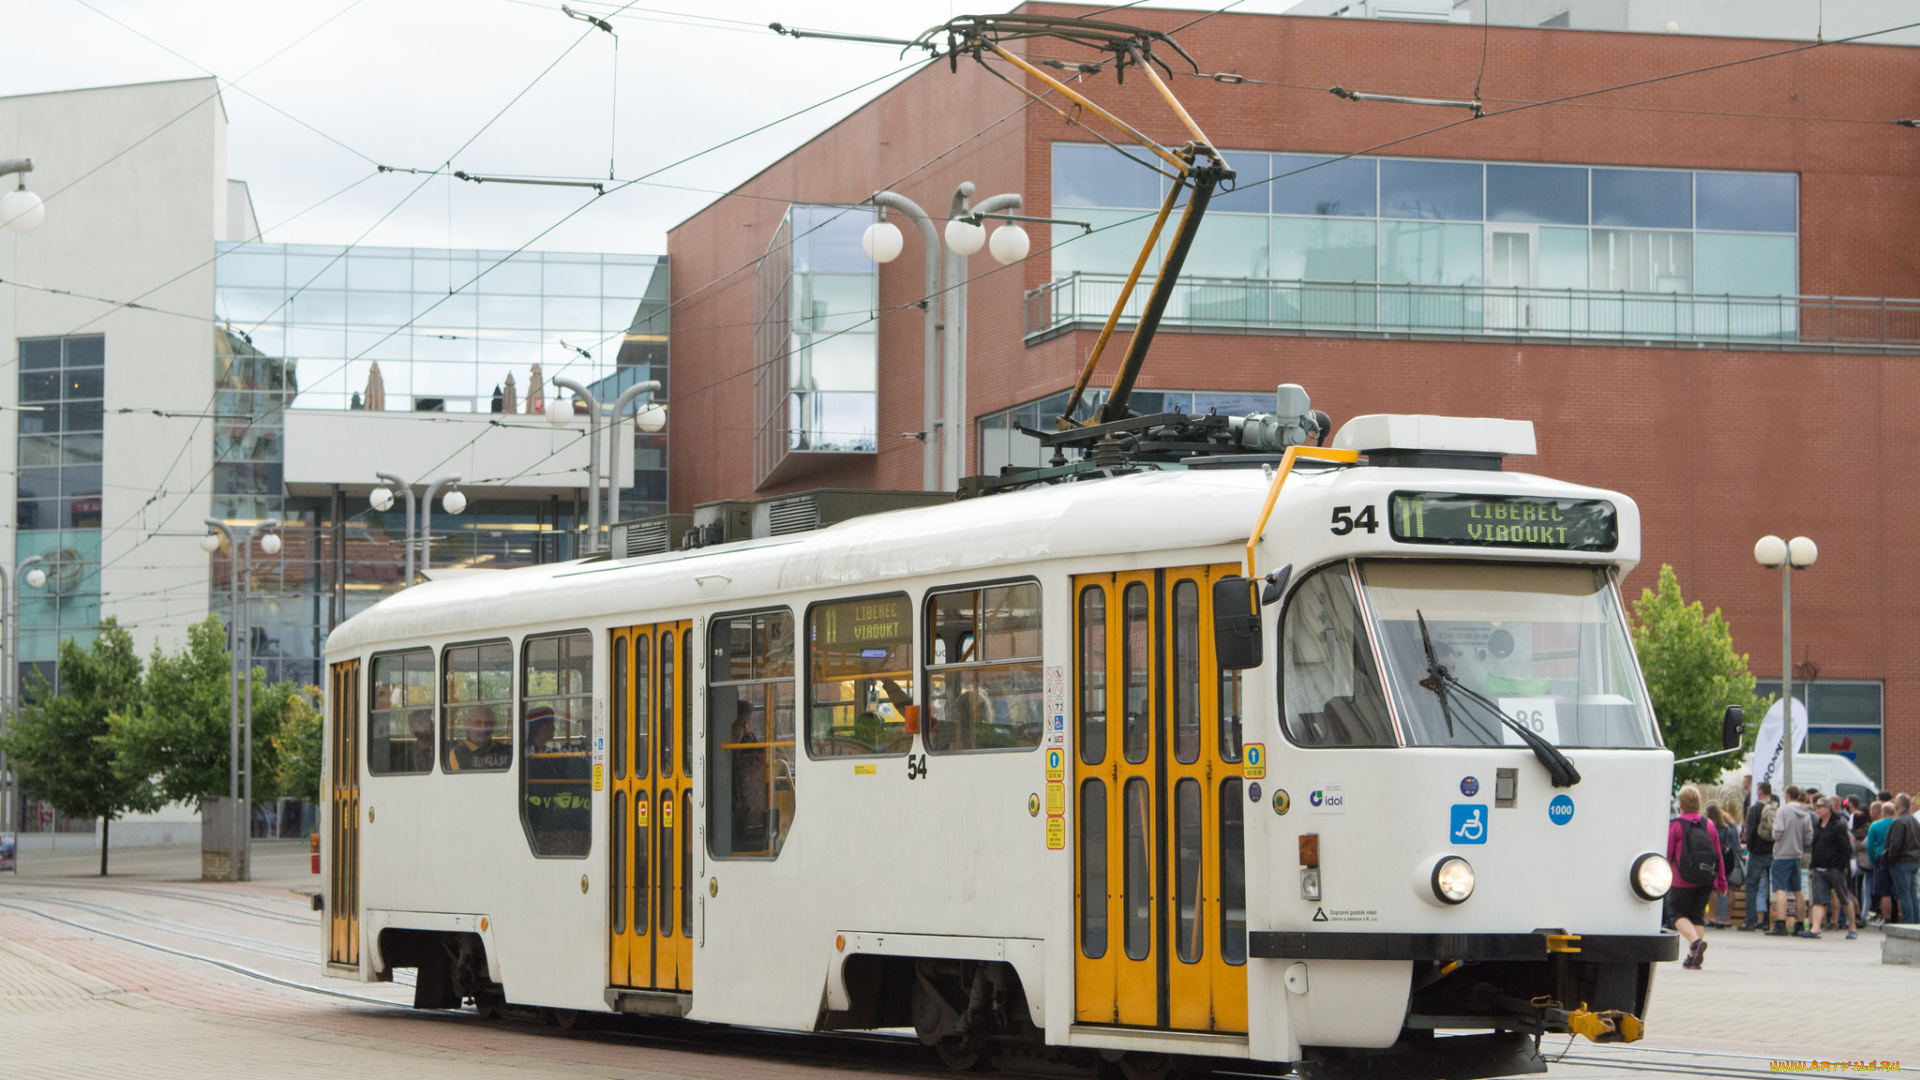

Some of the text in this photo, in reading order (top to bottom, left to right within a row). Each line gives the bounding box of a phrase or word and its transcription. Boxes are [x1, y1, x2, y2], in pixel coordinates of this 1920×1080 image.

[1330, 505, 1379, 536] 54
[1398, 498, 1424, 538] 11
[1470, 502, 1564, 521] LIBEREC
[1468, 523, 1568, 544] VIADUKT
[855, 603, 897, 621] LIBEREC
[854, 622, 899, 639] VIADUKT
[1516, 710, 1544, 733] 86
[907, 754, 927, 780] 54
[1324, 796, 1343, 806] idol
[1550, 805, 1572, 815] 1000
